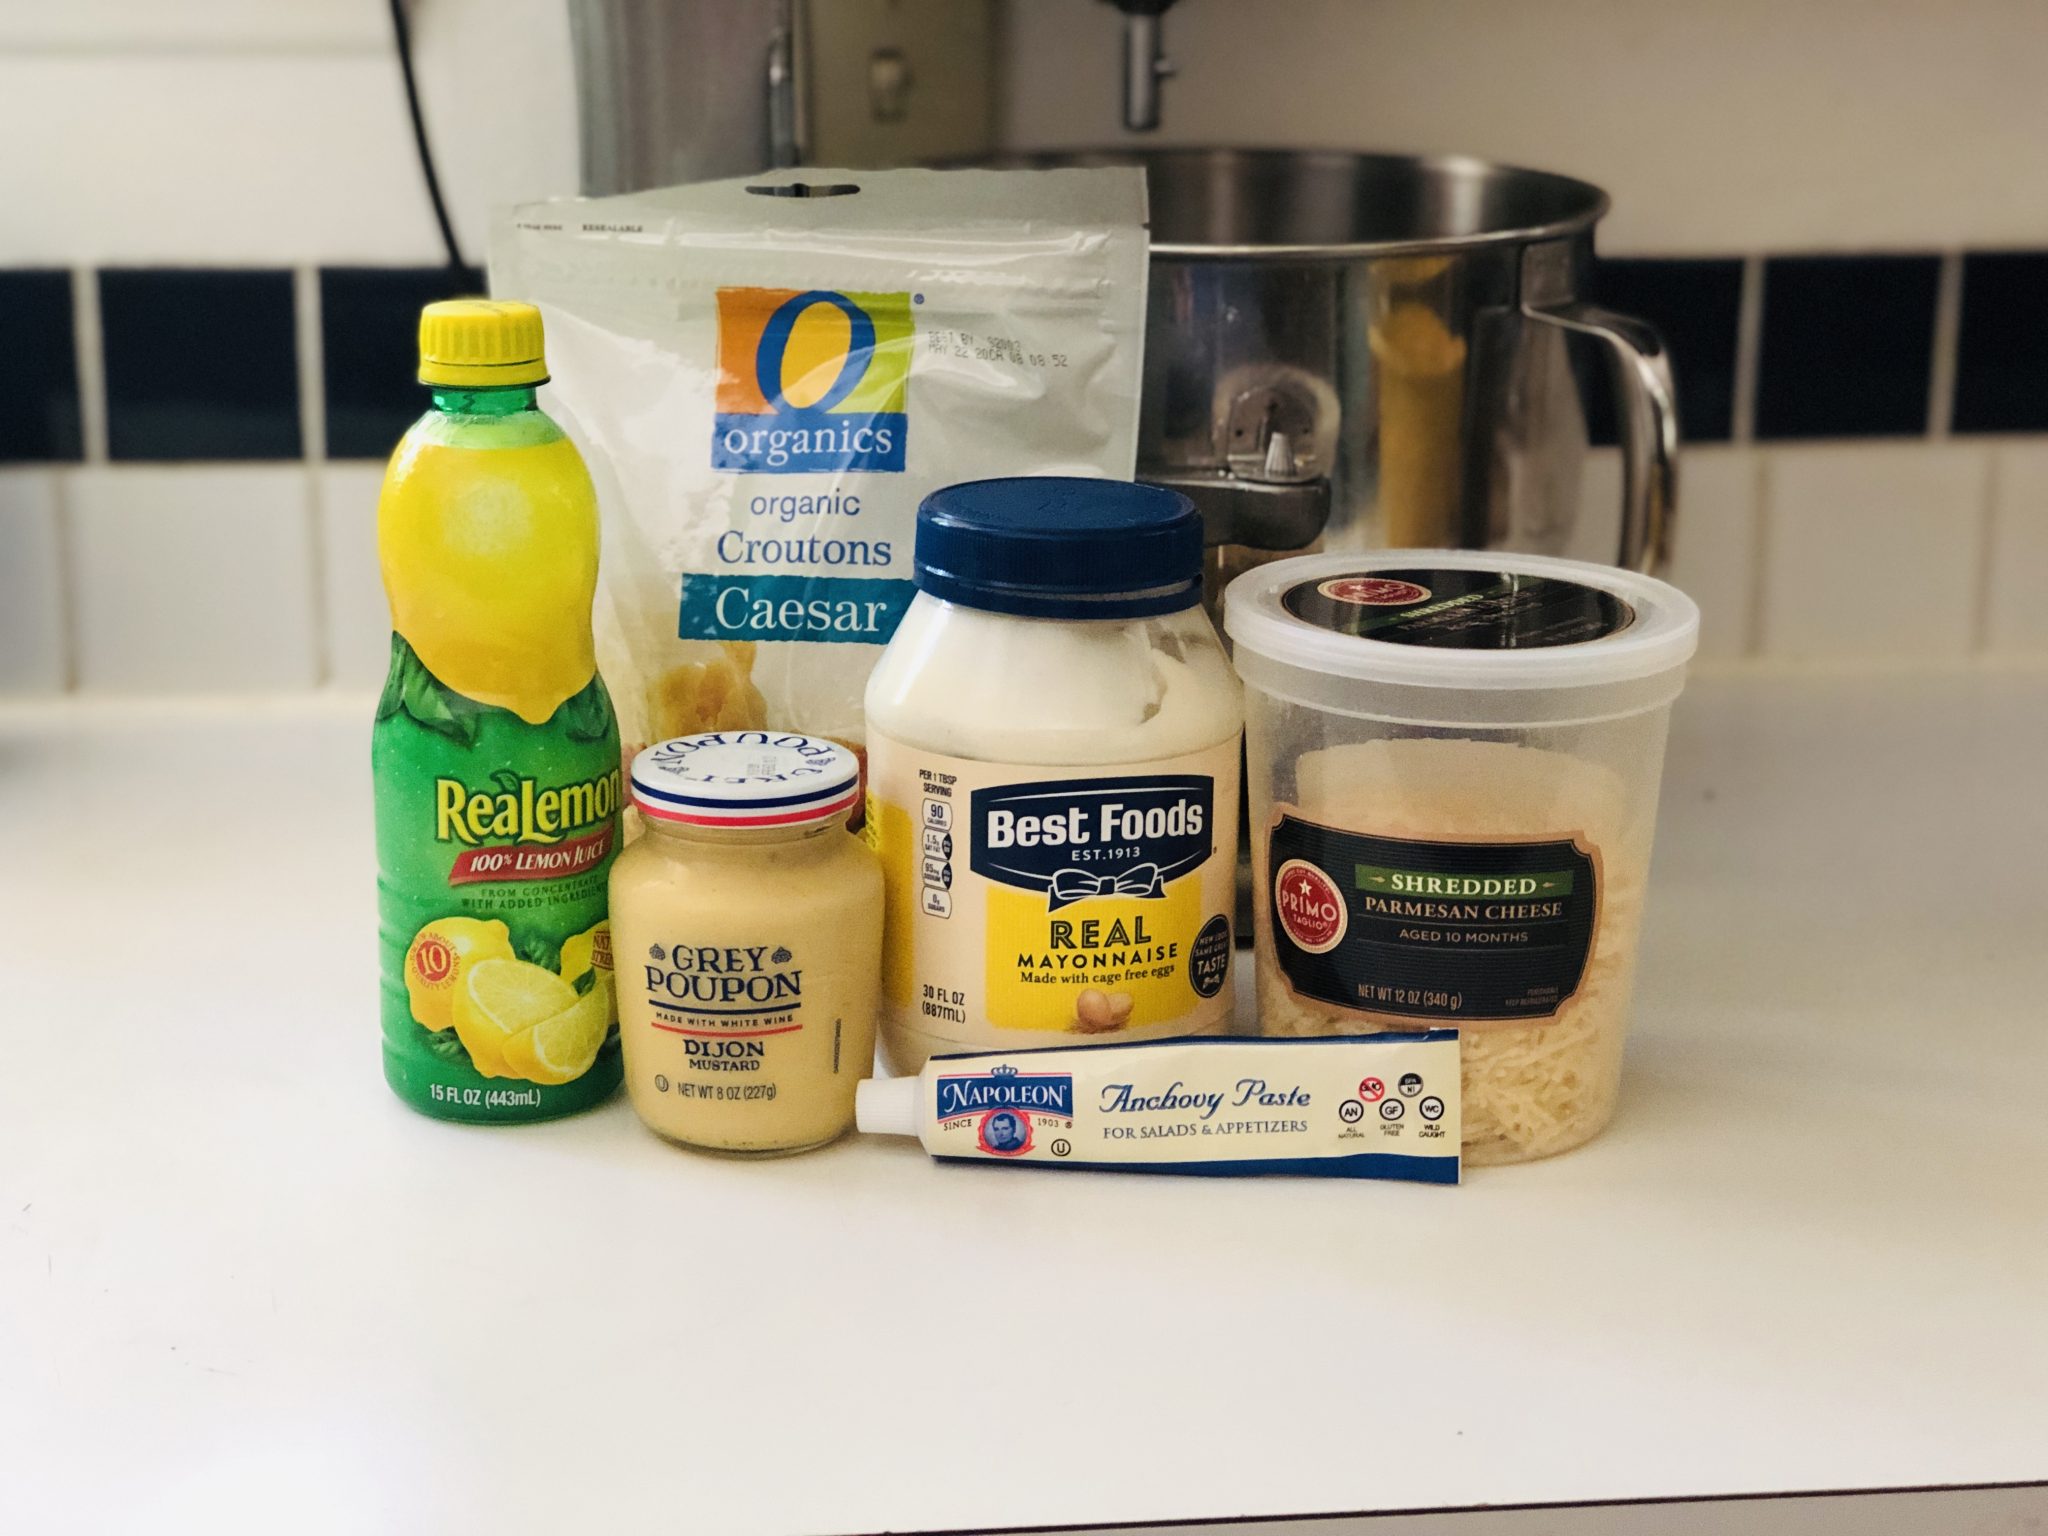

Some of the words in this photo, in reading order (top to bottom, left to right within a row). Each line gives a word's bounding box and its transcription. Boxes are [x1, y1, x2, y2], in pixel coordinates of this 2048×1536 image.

[955, 345, 969, 358] 22
[724, 419, 892, 466] organics
[751, 488, 860, 522] organic
[717, 530, 892, 566] Croutons
[716, 586, 887, 632] Caesar
[919, 769, 932, 780] PER
[939, 773, 957, 785] TBSP
[923, 783, 952, 798] SERVING
[437, 768, 620, 845] ReaLemon
[930, 803, 944, 819] 90
[987, 807, 1091, 849] Best
[1100, 798, 1203, 842] Foods
[470, 853, 513, 872] 100%
[515, 850, 571, 871] LEMON
[572, 839, 606, 868] JUICE
[1071, 846, 1142, 861] EST.1913
[481, 887, 516, 898] FROM
[1391, 873, 1537, 896] SHREDDED
[462, 897, 492, 910] WITH
[500, 897, 542, 910] ADDED
[1282, 890, 1338, 922] PRIMO
[1365, 896, 1480, 919] PARMESAN
[1485, 902, 1563, 920] CHEESE
[1050, 915, 1152, 950] REAL
[1400, 928, 1441, 942] AGED
[1446, 931, 1460, 942] 10
[1466, 931, 1529, 943] MONTHS
[419, 945, 447, 976] 10
[672, 944, 768, 973] GREY
[1017, 943, 1178, 969] MAYONNAISE
[1197, 954, 1226, 976] TASTE
[644, 965, 803, 1002] POUPON
[1021, 971, 1057, 984] Made
[1061, 973, 1090, 984] with
[1093, 972, 1122, 985] cage
[1125, 968, 1149, 981] free
[1151, 964, 1175, 977] eggs
[923, 984, 934, 999] 30
[937, 988, 949, 1003] FL
[952, 991, 965, 1006] OZ
[1358, 983, 1375, 998] NET
[1377, 987, 1393, 1001] WT
[1394, 989, 1406, 1001] 12
[1407, 991, 1420, 1005] OZ
[1423, 990, 1448, 1007] (340
[655, 1012, 682, 1024] MADE
[687, 1017, 716, 1027] WITH
[721, 1019, 759, 1027] WHITE
[764, 1014, 793, 1025] WINE
[922, 1000, 966, 1024] (887mL)
[683, 1039, 765, 1058] DIJON
[689, 1058, 760, 1072] MUSTARD
[430, 1083, 444, 1101] 15
[446, 1086, 462, 1104] FL
[463, 1089, 481, 1106] OZ
[485, 1088, 541, 1109] (443mL)
[678, 1082, 695, 1097] NET
[698, 1085, 714, 1099] WT
[717, 1086, 724, 1100] 8
[726, 1086, 741, 1100] OZ
[743, 1082, 777, 1101] (227g)
[943, 1081, 1067, 1113] NAPOLEON
[1099, 1082, 1224, 1119] Anchovy
[1232, 1079, 1311, 1108] Paste
[1344, 1107, 1358, 1117] AN
[1384, 1106, 1399, 1115] GF
[1424, 1104, 1440, 1113] WC
[943, 1118, 972, 1131] SINCE
[1037, 1118, 1059, 1128] 1903
[1103, 1126, 1137, 1140] FOR
[1140, 1123, 1197, 1138] SALADS
[1202, 1124, 1212, 1135] &
[1215, 1120, 1308, 1135] APPETIZERS
[1380, 1123, 1404, 1131] GLUTEN
[1418, 1131, 1446, 1139] CAUGHT
